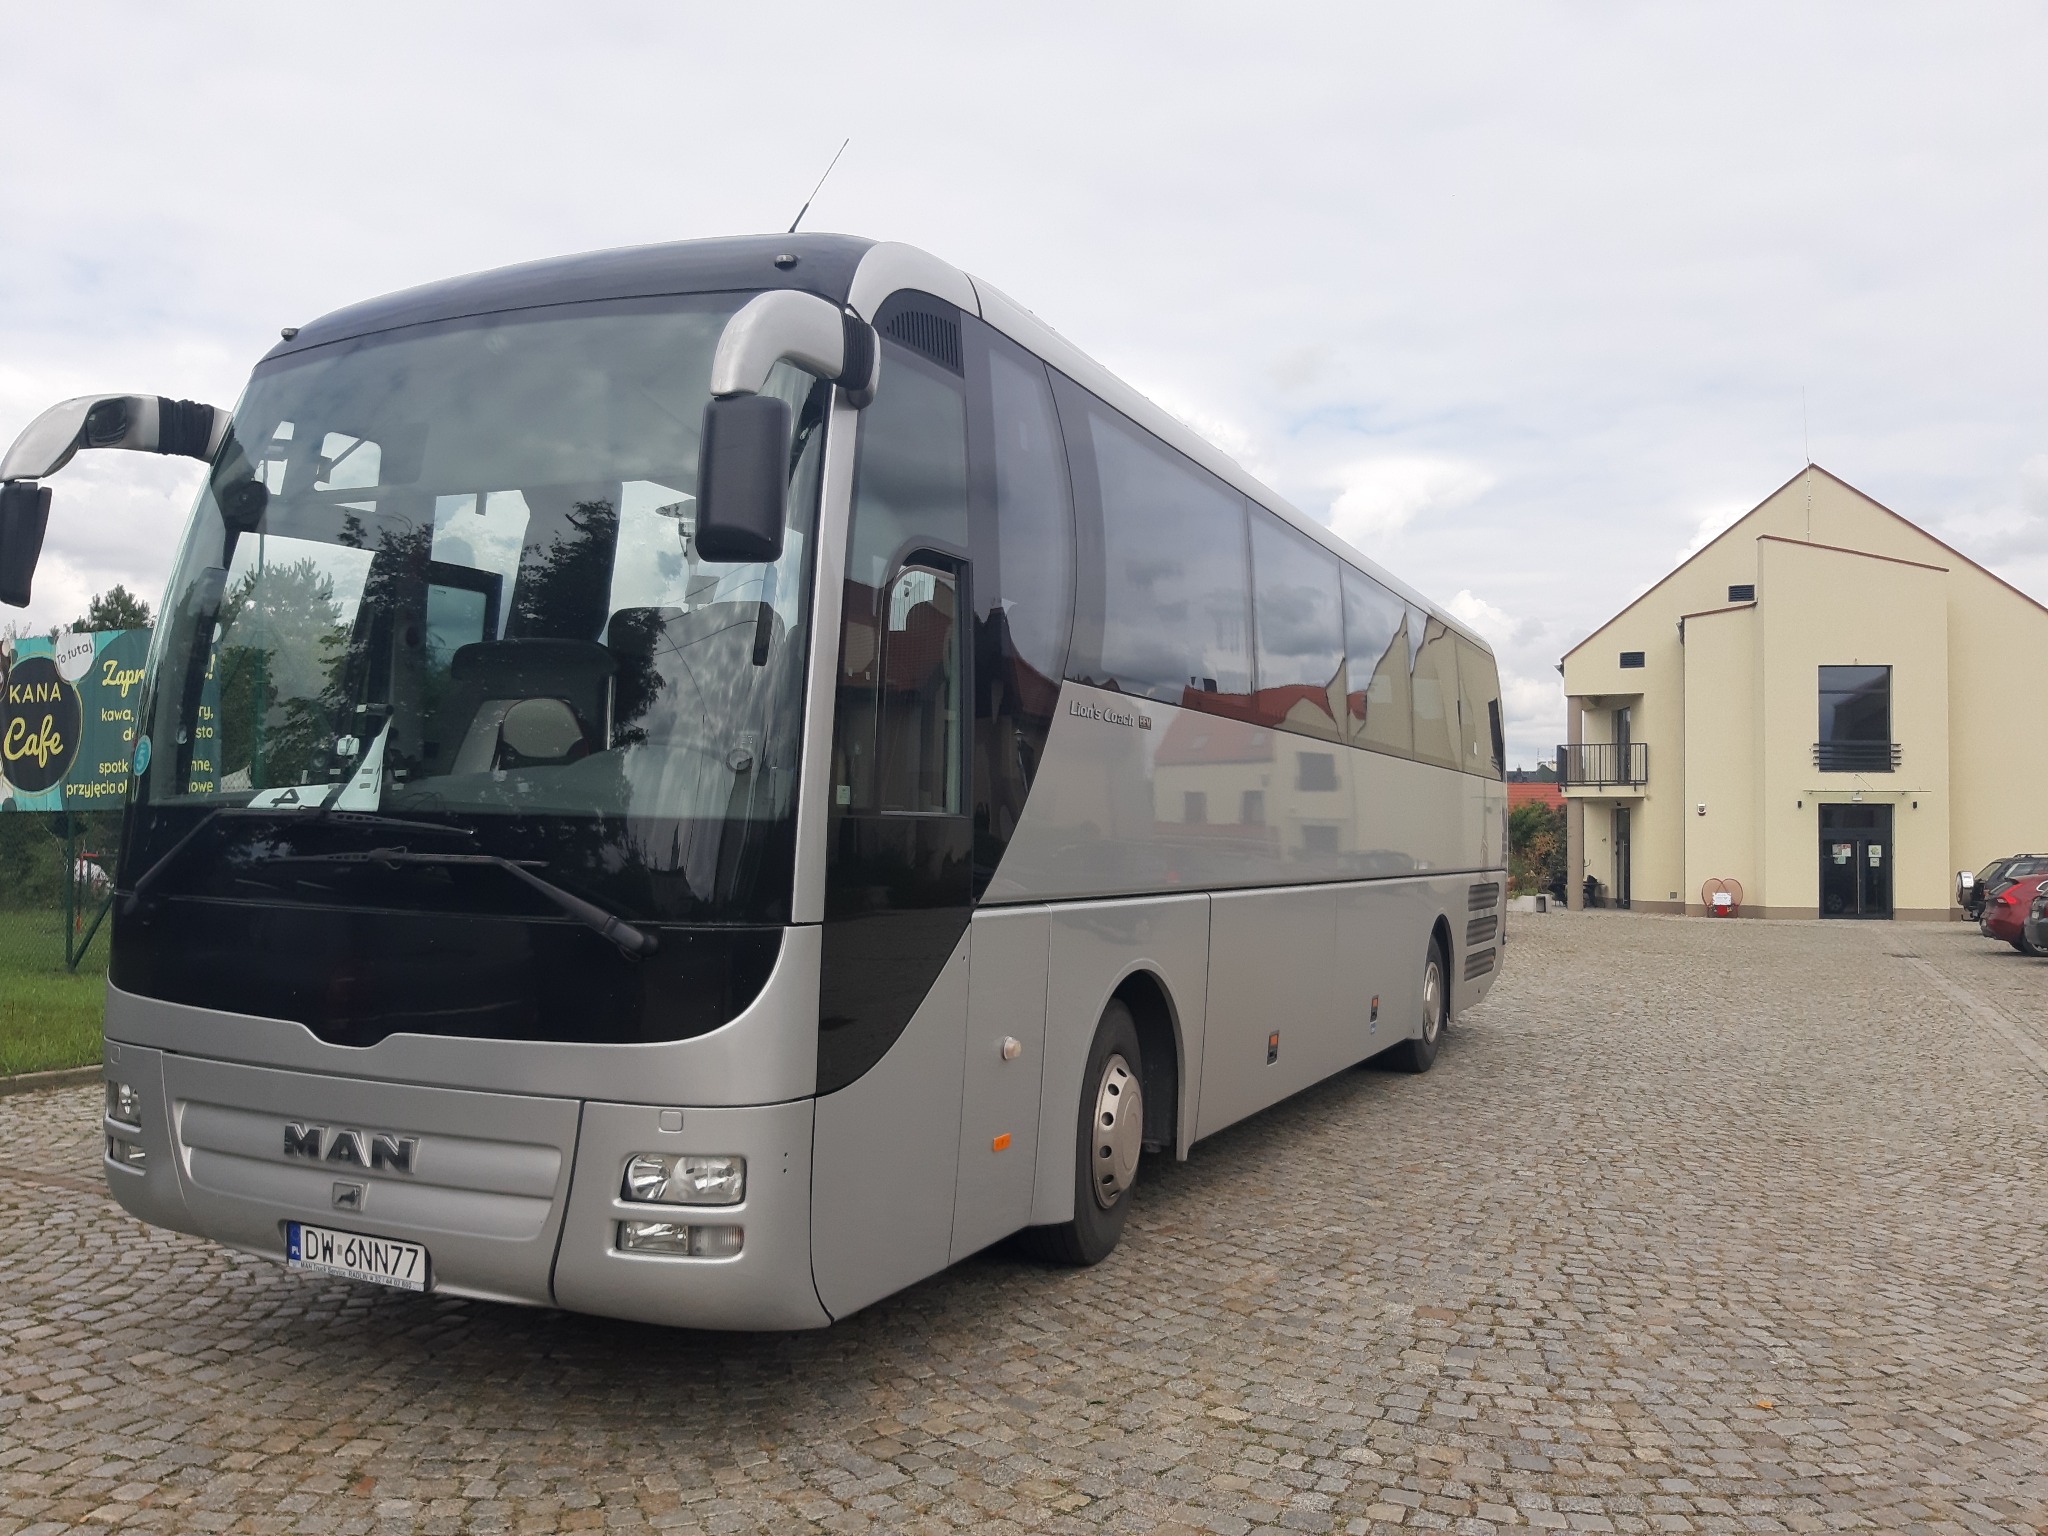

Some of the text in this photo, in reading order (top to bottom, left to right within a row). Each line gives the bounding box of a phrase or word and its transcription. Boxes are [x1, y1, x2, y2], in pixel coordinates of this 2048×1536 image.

[57, 640, 93, 666] To tutaj
[9, 682, 61, 704] KANA
[101, 707, 134, 722] kawa,
[1069, 700, 1102, 721] Lion's
[1103, 708, 1135, 727] Coach
[3, 714, 64, 768] Cafe
[66, 780, 116, 799] przyjęcia
[284, 1121, 421, 1174] MAN
[291, 1245, 300, 1256] PL
[305, 1230, 419, 1279] DW 6NN77
